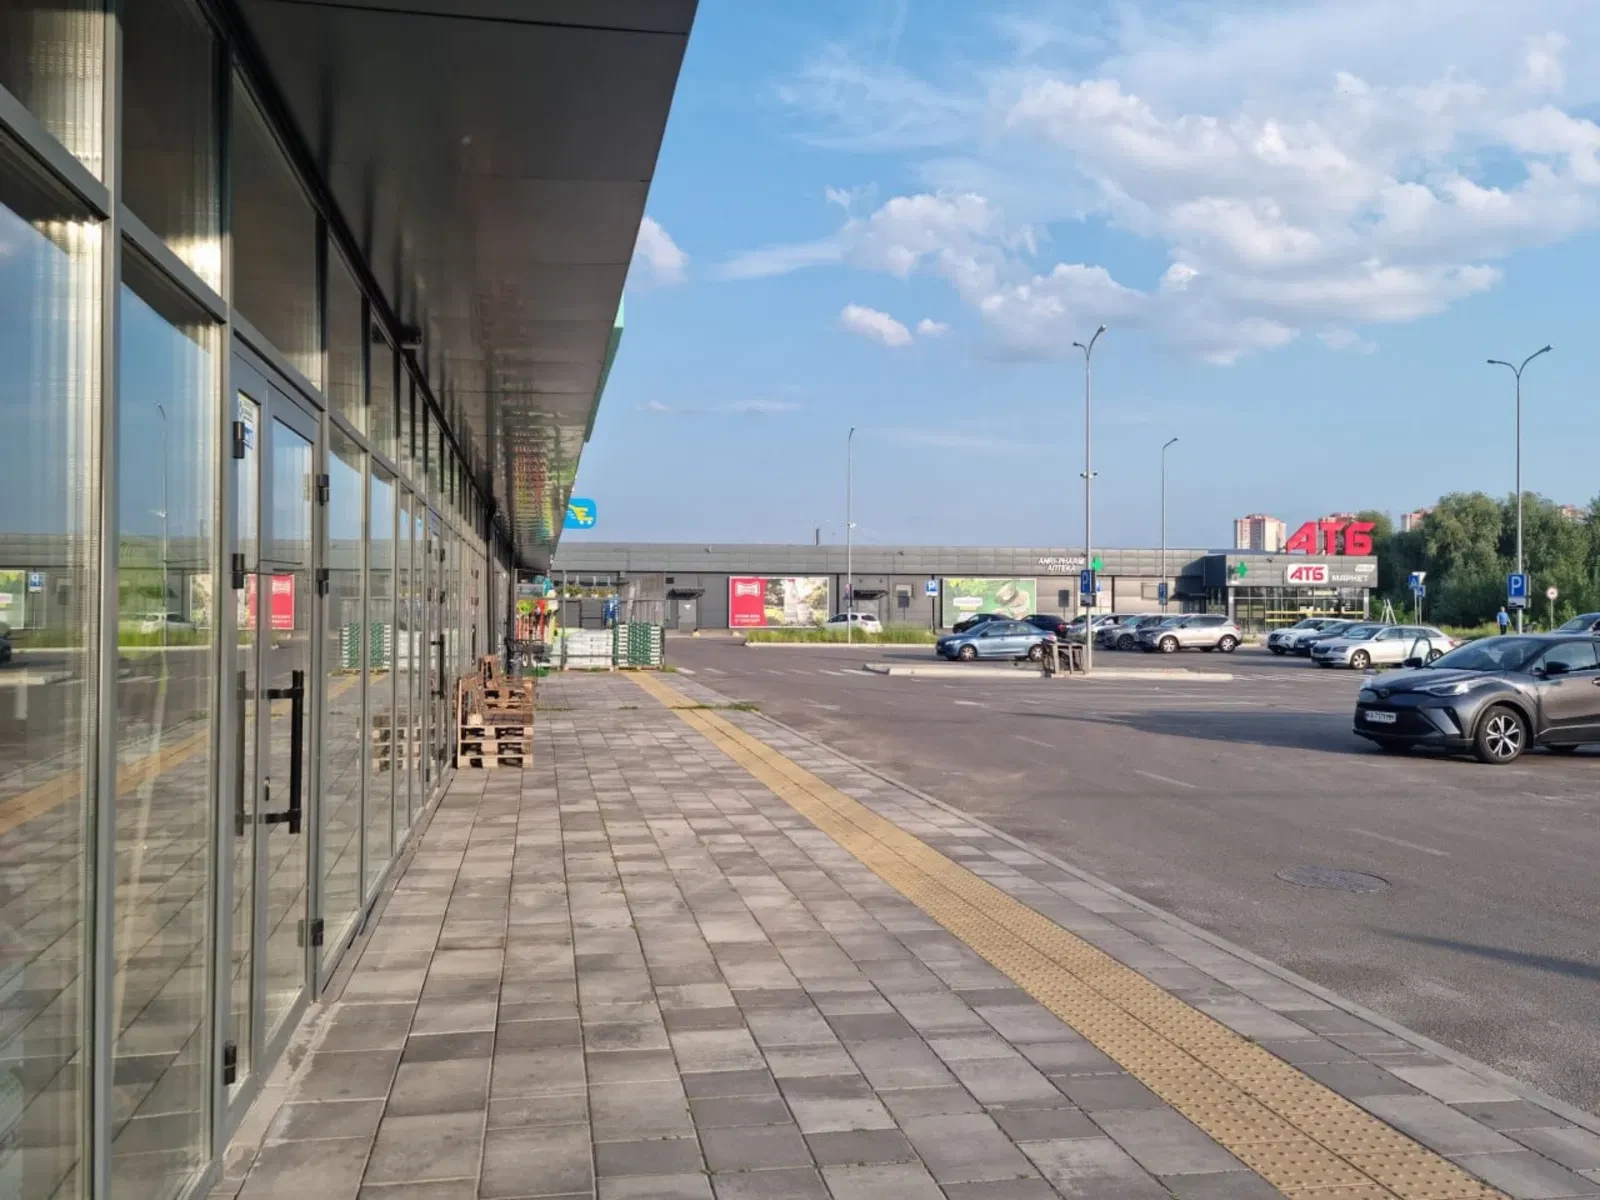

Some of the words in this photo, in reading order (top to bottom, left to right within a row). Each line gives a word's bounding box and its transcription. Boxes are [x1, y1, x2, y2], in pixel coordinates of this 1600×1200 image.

[1286, 521, 1376, 556] АТБ
[1290, 566, 1325, 581] АТБ
[1331, 574, 1369, 582] МАРКЕТ
